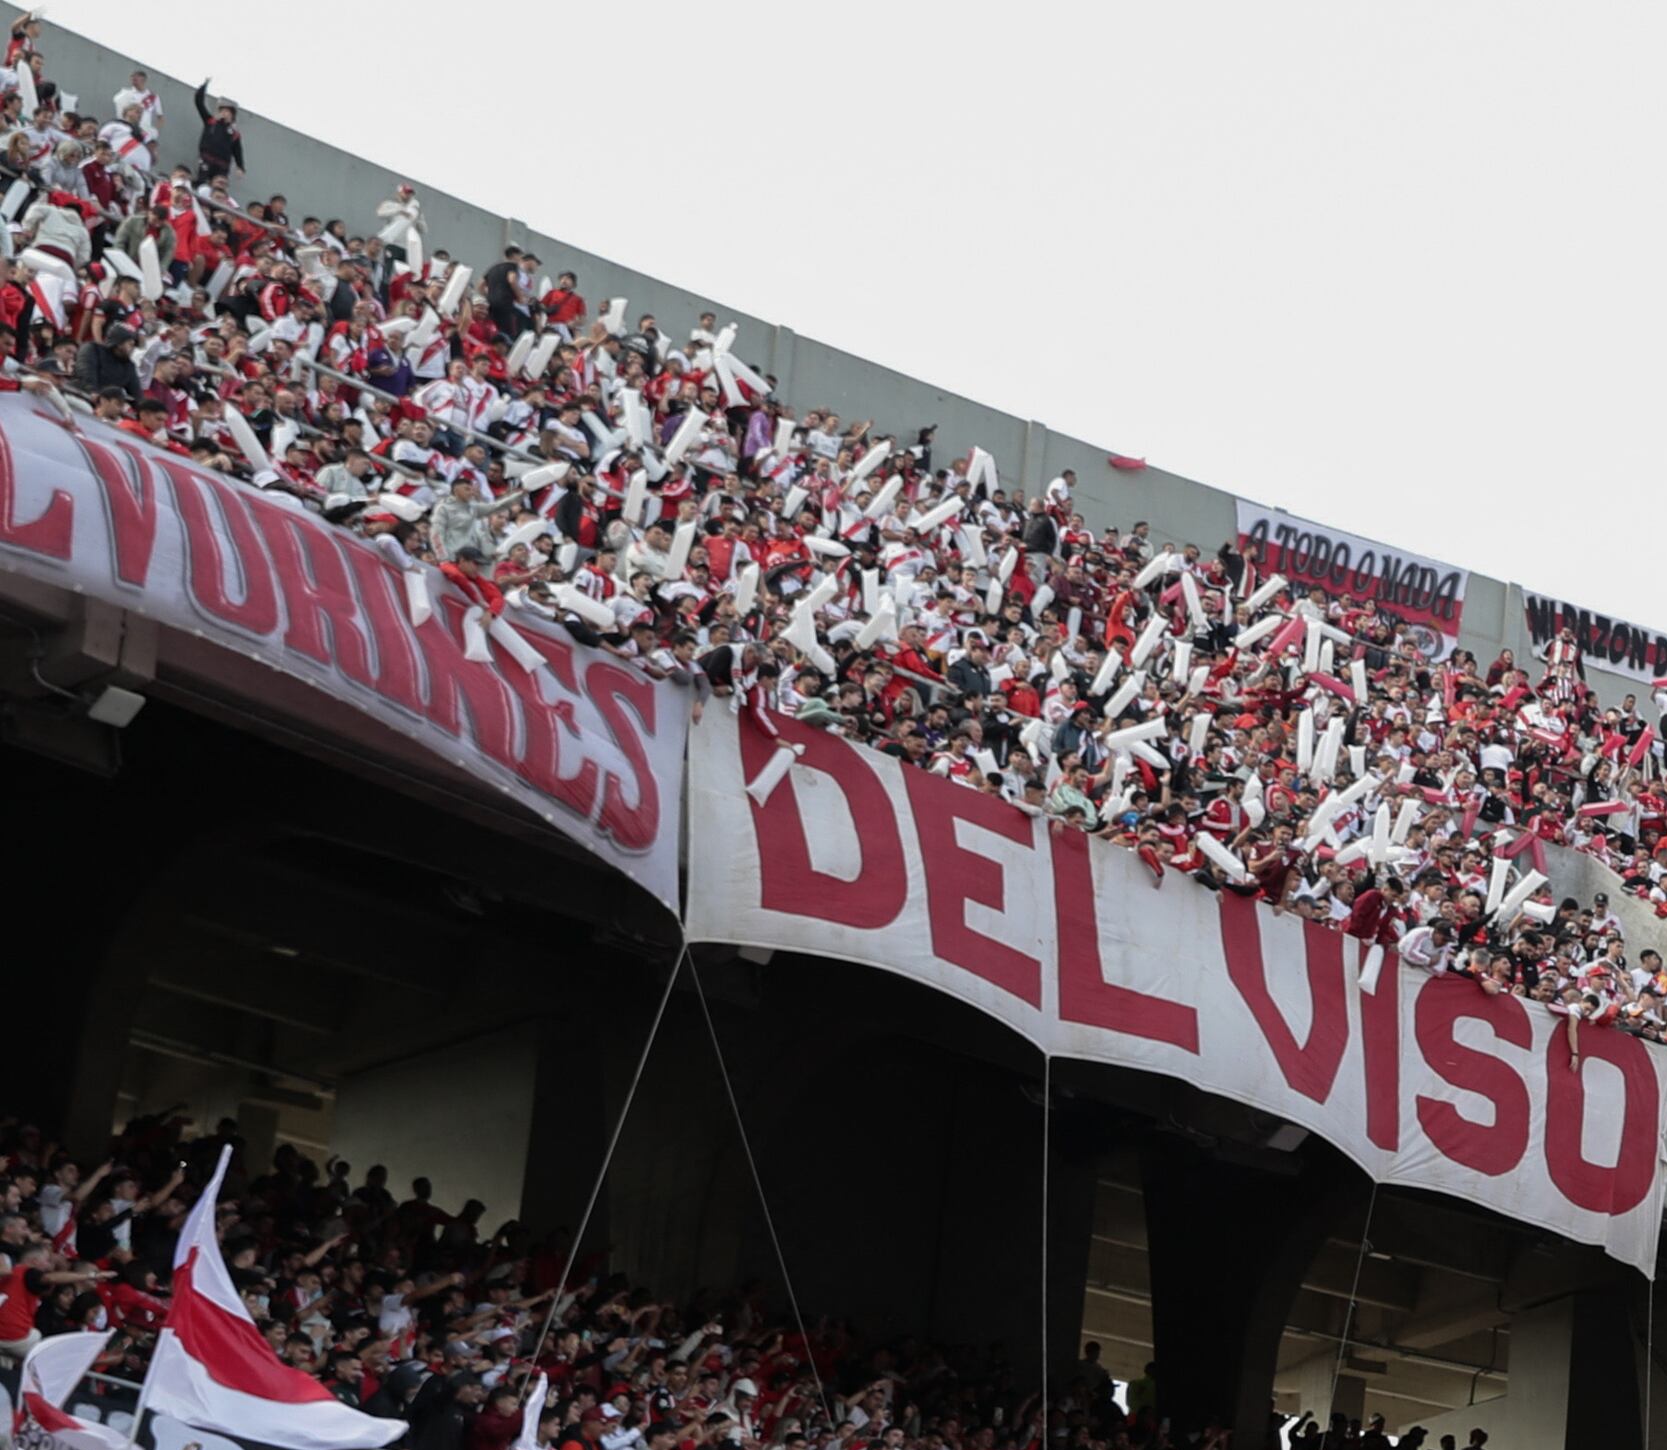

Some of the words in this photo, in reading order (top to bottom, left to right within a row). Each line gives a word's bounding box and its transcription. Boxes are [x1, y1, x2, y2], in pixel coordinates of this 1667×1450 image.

[1249, 518, 1269, 564] A
[1275, 523, 1351, 585] TODO
[1355, 549, 1376, 593] O
[1377, 553, 1462, 620] NADA
[736, 706, 1202, 1056] DEL
[1219, 886, 1661, 1217] VISO
